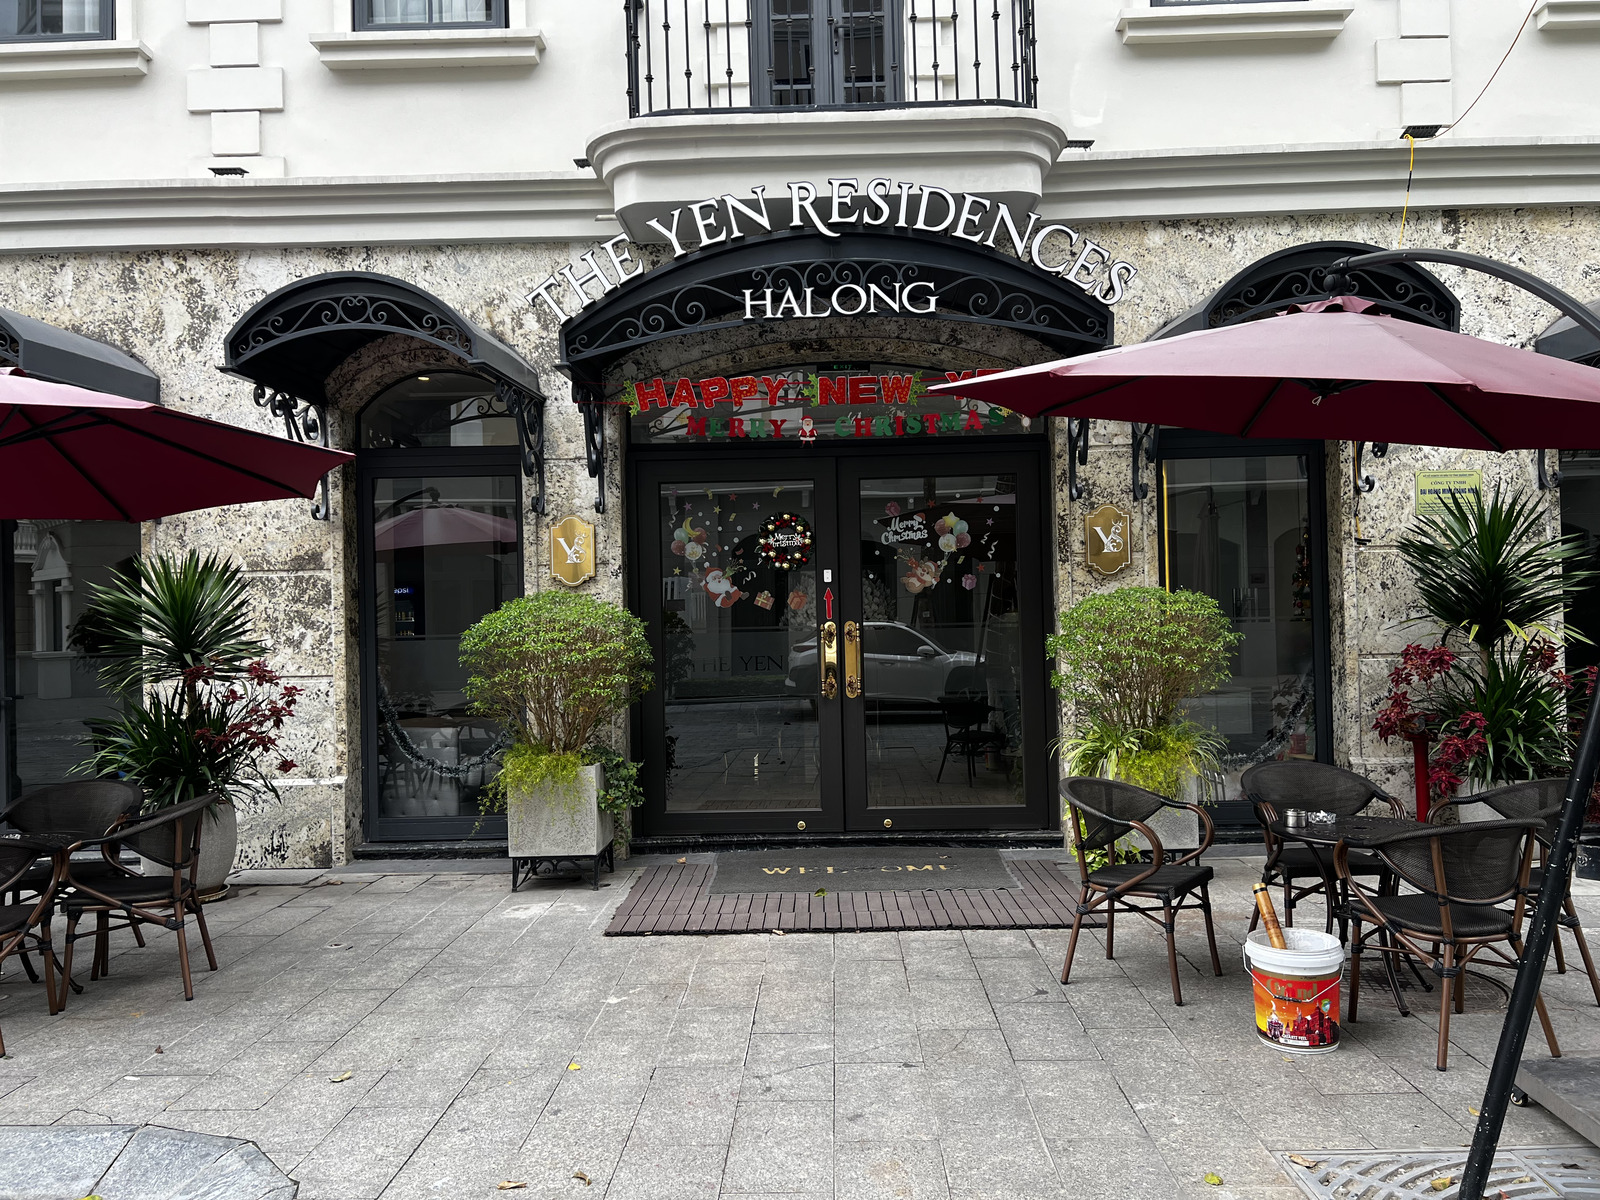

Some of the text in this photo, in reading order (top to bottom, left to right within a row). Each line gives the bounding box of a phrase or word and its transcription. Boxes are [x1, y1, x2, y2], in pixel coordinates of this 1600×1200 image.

[524, 178, 1138, 325] THE YEN RESIDENCES
[742, 282, 940, 320] HALONG
[634, 376, 788, 411] HAPPY
[817, 375, 914, 405] NEW
[685, 407, 1005, 438] MERRY CHRISTMAS
[881, 529, 928, 545] Christmas
[887, 517, 924, 532] Merry
[739, 655, 784, 672] YEN
